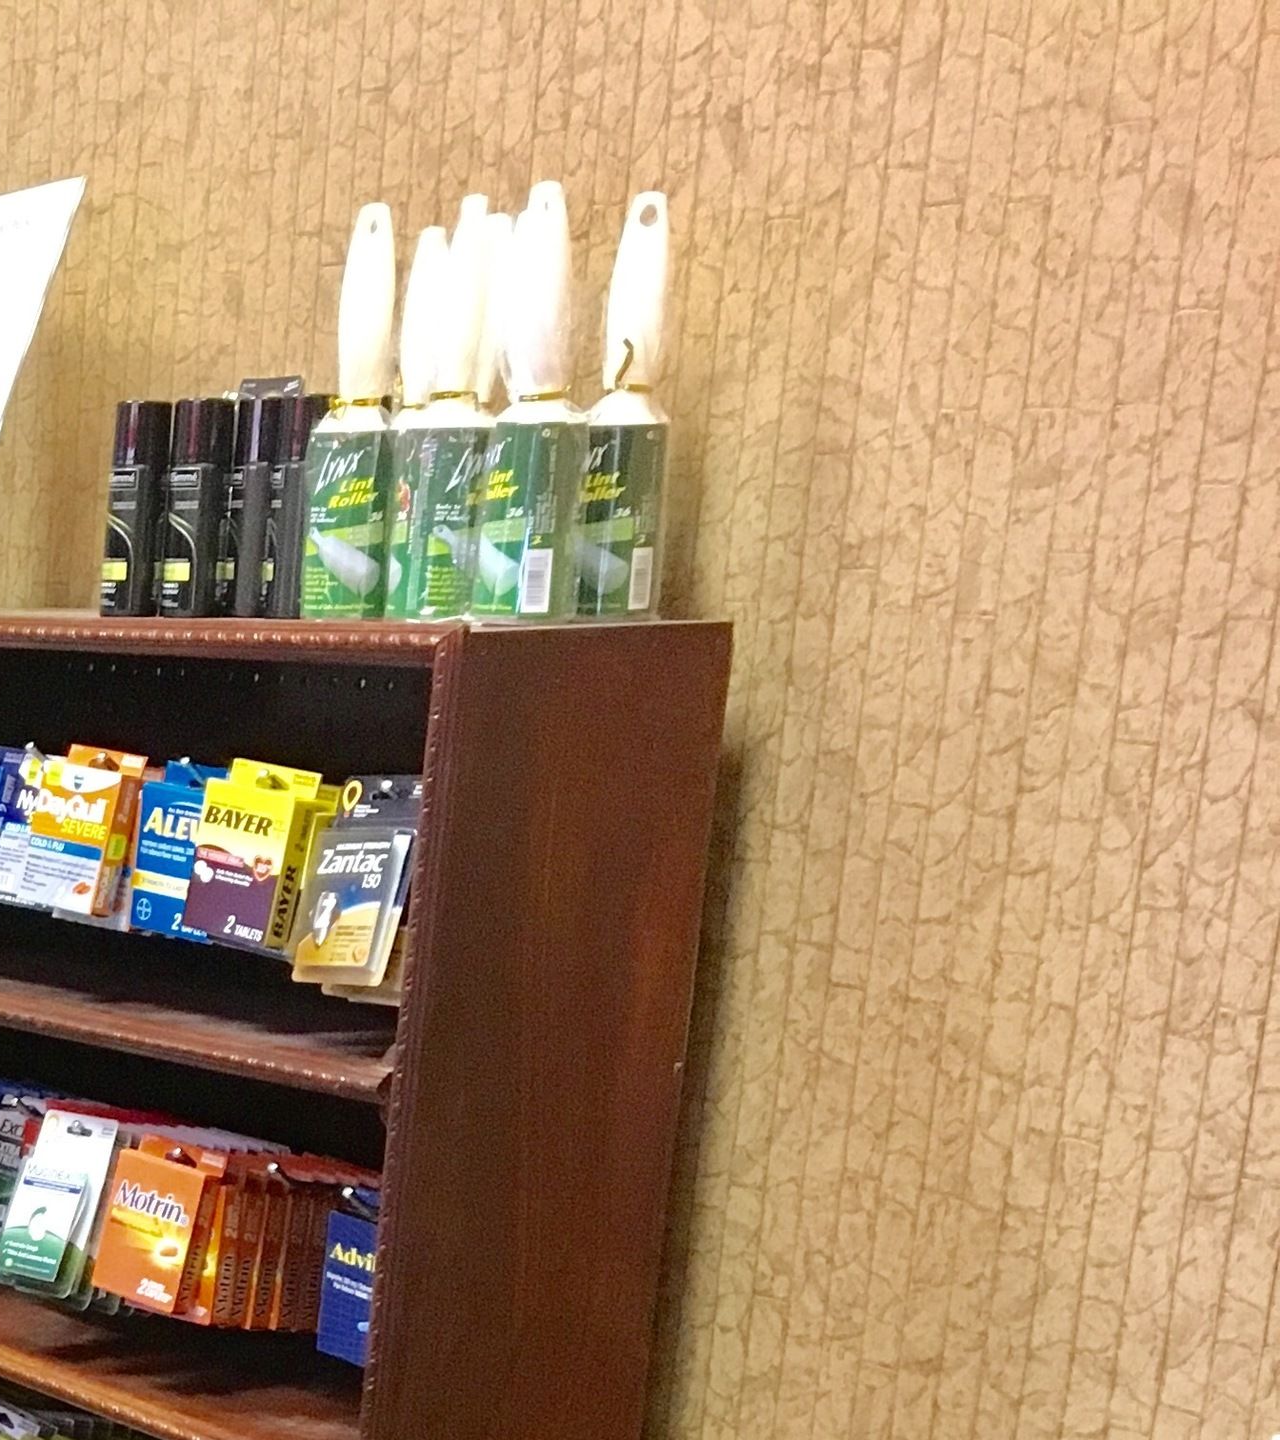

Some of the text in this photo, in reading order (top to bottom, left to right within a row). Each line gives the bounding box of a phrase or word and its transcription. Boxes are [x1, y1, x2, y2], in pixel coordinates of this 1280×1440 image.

[340, 476, 375, 494] Lint
[328, 491, 380, 509] Roller
[61, 817, 108, 841] SEVERE
[204, 804, 273, 838] BAYER
[316, 848, 389, 876] Zantac
[361, 874, 383, 889] 150
[224, 914, 264, 943] 2 TABLETS
[117, 1181, 183, 1223] Motrin
[329, 1241, 376, 1274] Advil
